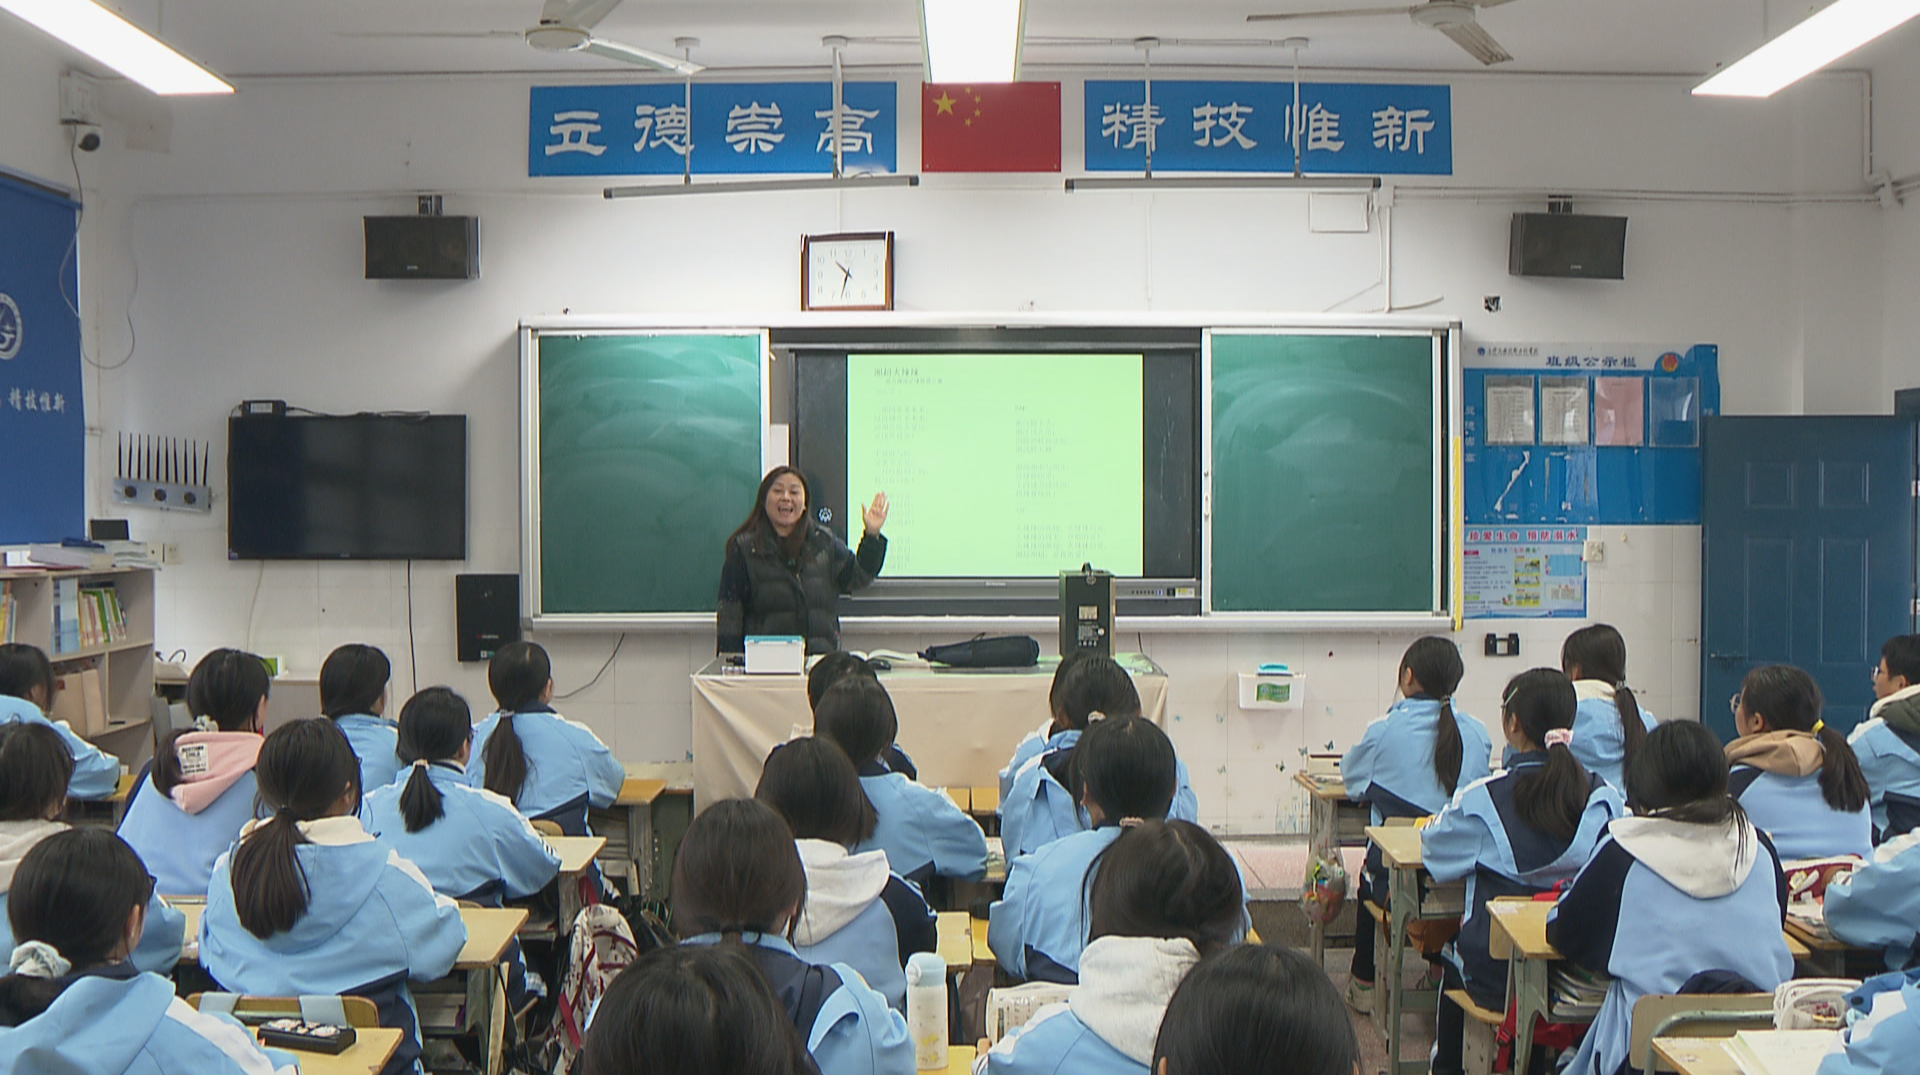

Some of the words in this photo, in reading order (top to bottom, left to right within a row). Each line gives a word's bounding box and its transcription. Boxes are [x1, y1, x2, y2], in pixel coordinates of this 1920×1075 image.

[545, 101, 880, 156] 立德崇高
[1102, 101, 1435, 154] 精技惟新
[1545, 355, 1637, 367] 班级公示栏
